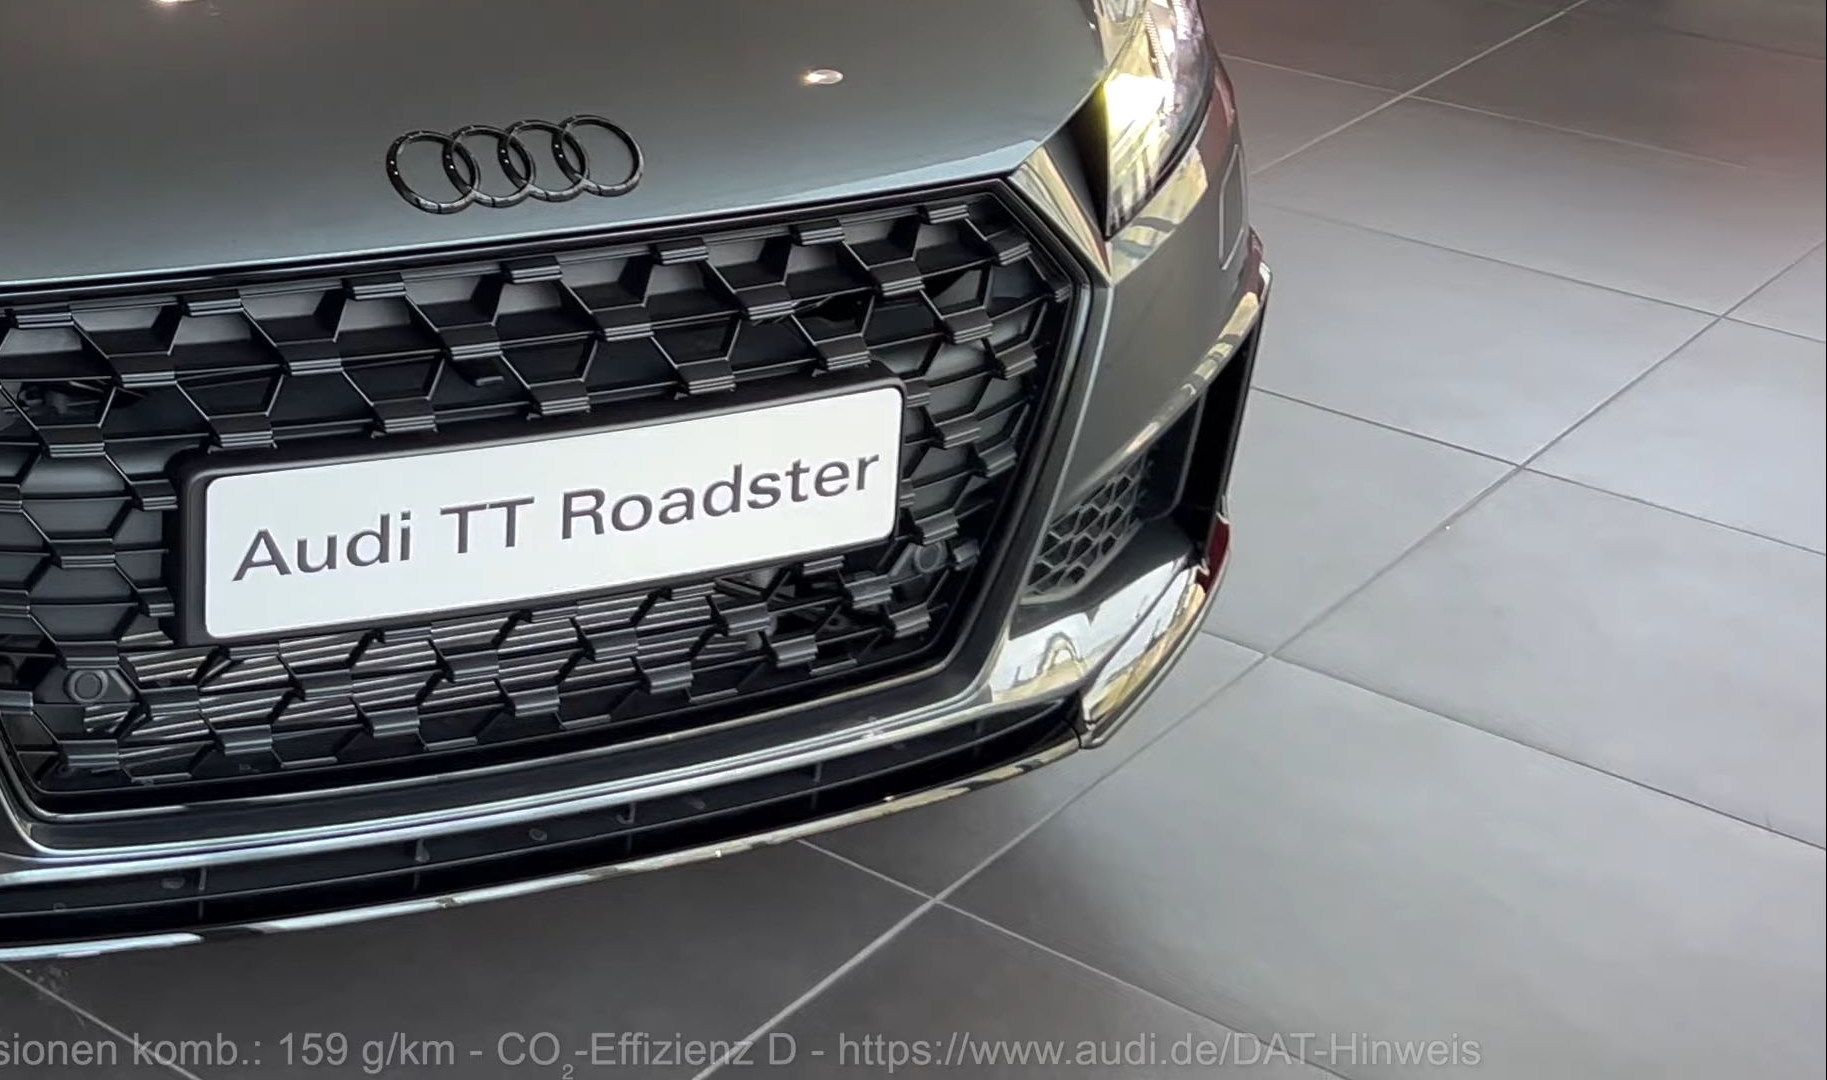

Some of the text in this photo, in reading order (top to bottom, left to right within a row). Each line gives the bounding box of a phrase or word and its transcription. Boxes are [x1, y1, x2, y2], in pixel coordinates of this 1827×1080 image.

[231, 453, 881, 582] Audi TT Roadster
